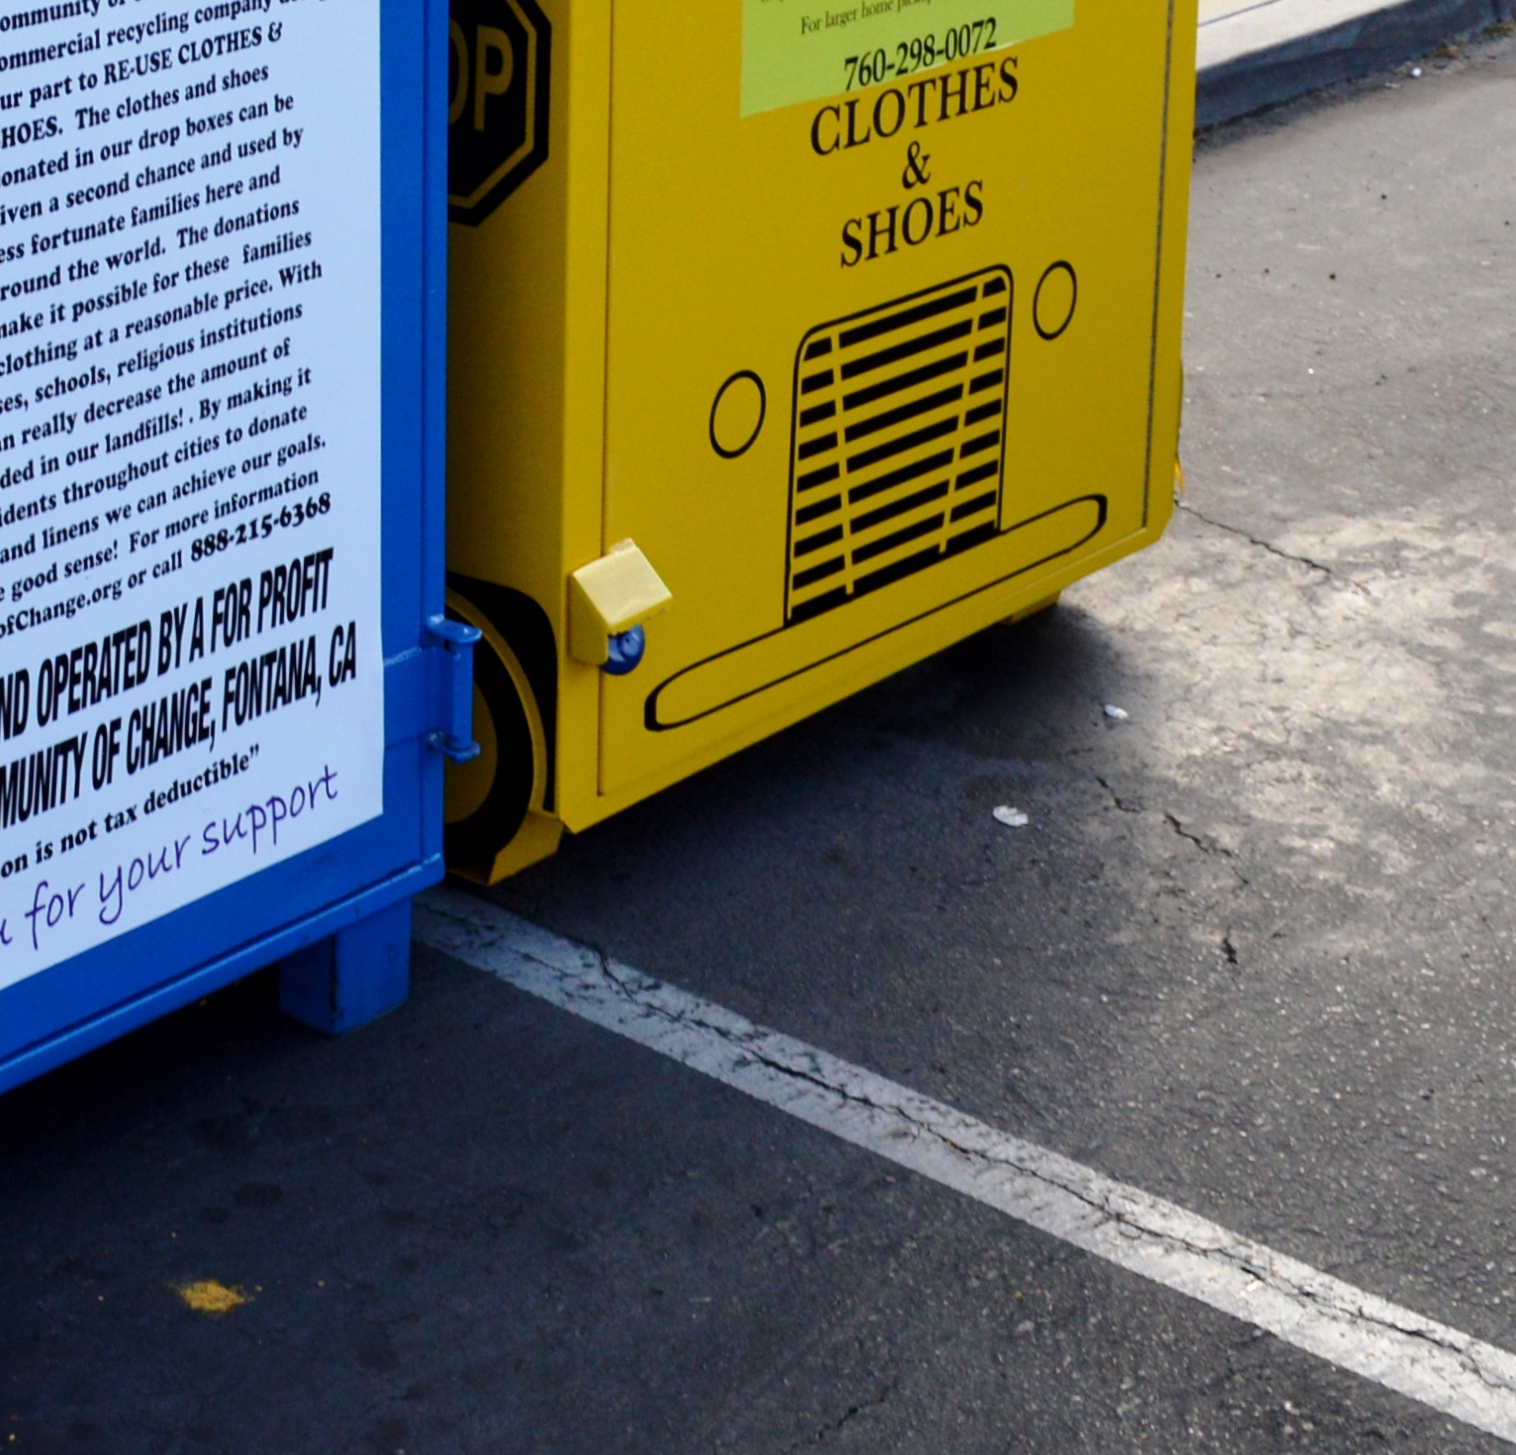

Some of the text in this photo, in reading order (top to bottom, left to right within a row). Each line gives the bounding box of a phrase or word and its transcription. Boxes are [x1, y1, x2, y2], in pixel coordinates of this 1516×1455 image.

[107, 12, 189, 47] recycling
[801, 15, 822, 36] For
[825, 8, 859, 29] larger
[861, 0, 894, 19] home
[844, 17, 997, 91] 760-298-0072
[29, 76, 72, 109] part
[78, 73, 98, 92] to
[104, 47, 172, 86] RE-USE
[178, 25, 262, 65] CLOTHES
[267, 21, 283, 43] &
[75, 105, 111, 130] The
[116, 88, 180, 119] clothes
[185, 73, 216, 101] and
[222, 65, 269, 91] shoes
[810, 56, 1018, 155] CLOTHES
[31, 215, 126, 256] fortunate
[131, 192, 200, 228] families
[205, 180, 243, 205] here
[248, 164, 281, 191] and
[902, 141, 931, 189] &
[67, 259, 99, 282] the
[105, 235, 166, 270] world.
[176, 225, 208, 249] The
[213, 199, 300, 237] donations
[840, 179, 983, 268] SHOES
[50, 303, 66, 325] it
[72, 279, 148, 323] possible
[153, 271, 180, 294] for
[184, 255, 230, 283] these
[243, 231, 312, 265] families
[35, 364, 111, 403] schools,
[117, 337, 195, 377] religious
[200, 303, 303, 349] institutions
[11, 562, 58, 603] good
[64, 539, 118, 579] sense!
[129, 528, 160, 554] For
[165, 509, 209, 539] more
[214, 470, 319, 519] information
[127, 569, 147, 590] or
[152, 549, 183, 580] call
[190, 491, 331, 563] 888-215-6368
[37, 619, 151, 727] OPERATED
[157, 602, 188, 677] BY
[189, 596, 204, 663] A
[210, 577, 252, 654] FOR
[257, 546, 334, 634] PROFIT
[92, 717, 122, 791] OF
[126, 676, 216, 776] CHANGE,
[221, 635, 322, 732] FONTANA,
[328, 620, 356, 688] CA
[35, 840, 54, 865] is
[60, 819, 98, 854] not
[104, 804, 138, 834] tax
[143, 743, 260, 816] deductible”
[24, 880, 86, 951] for
[99, 834, 191, 925] your
[201, 764, 338, 856] support
